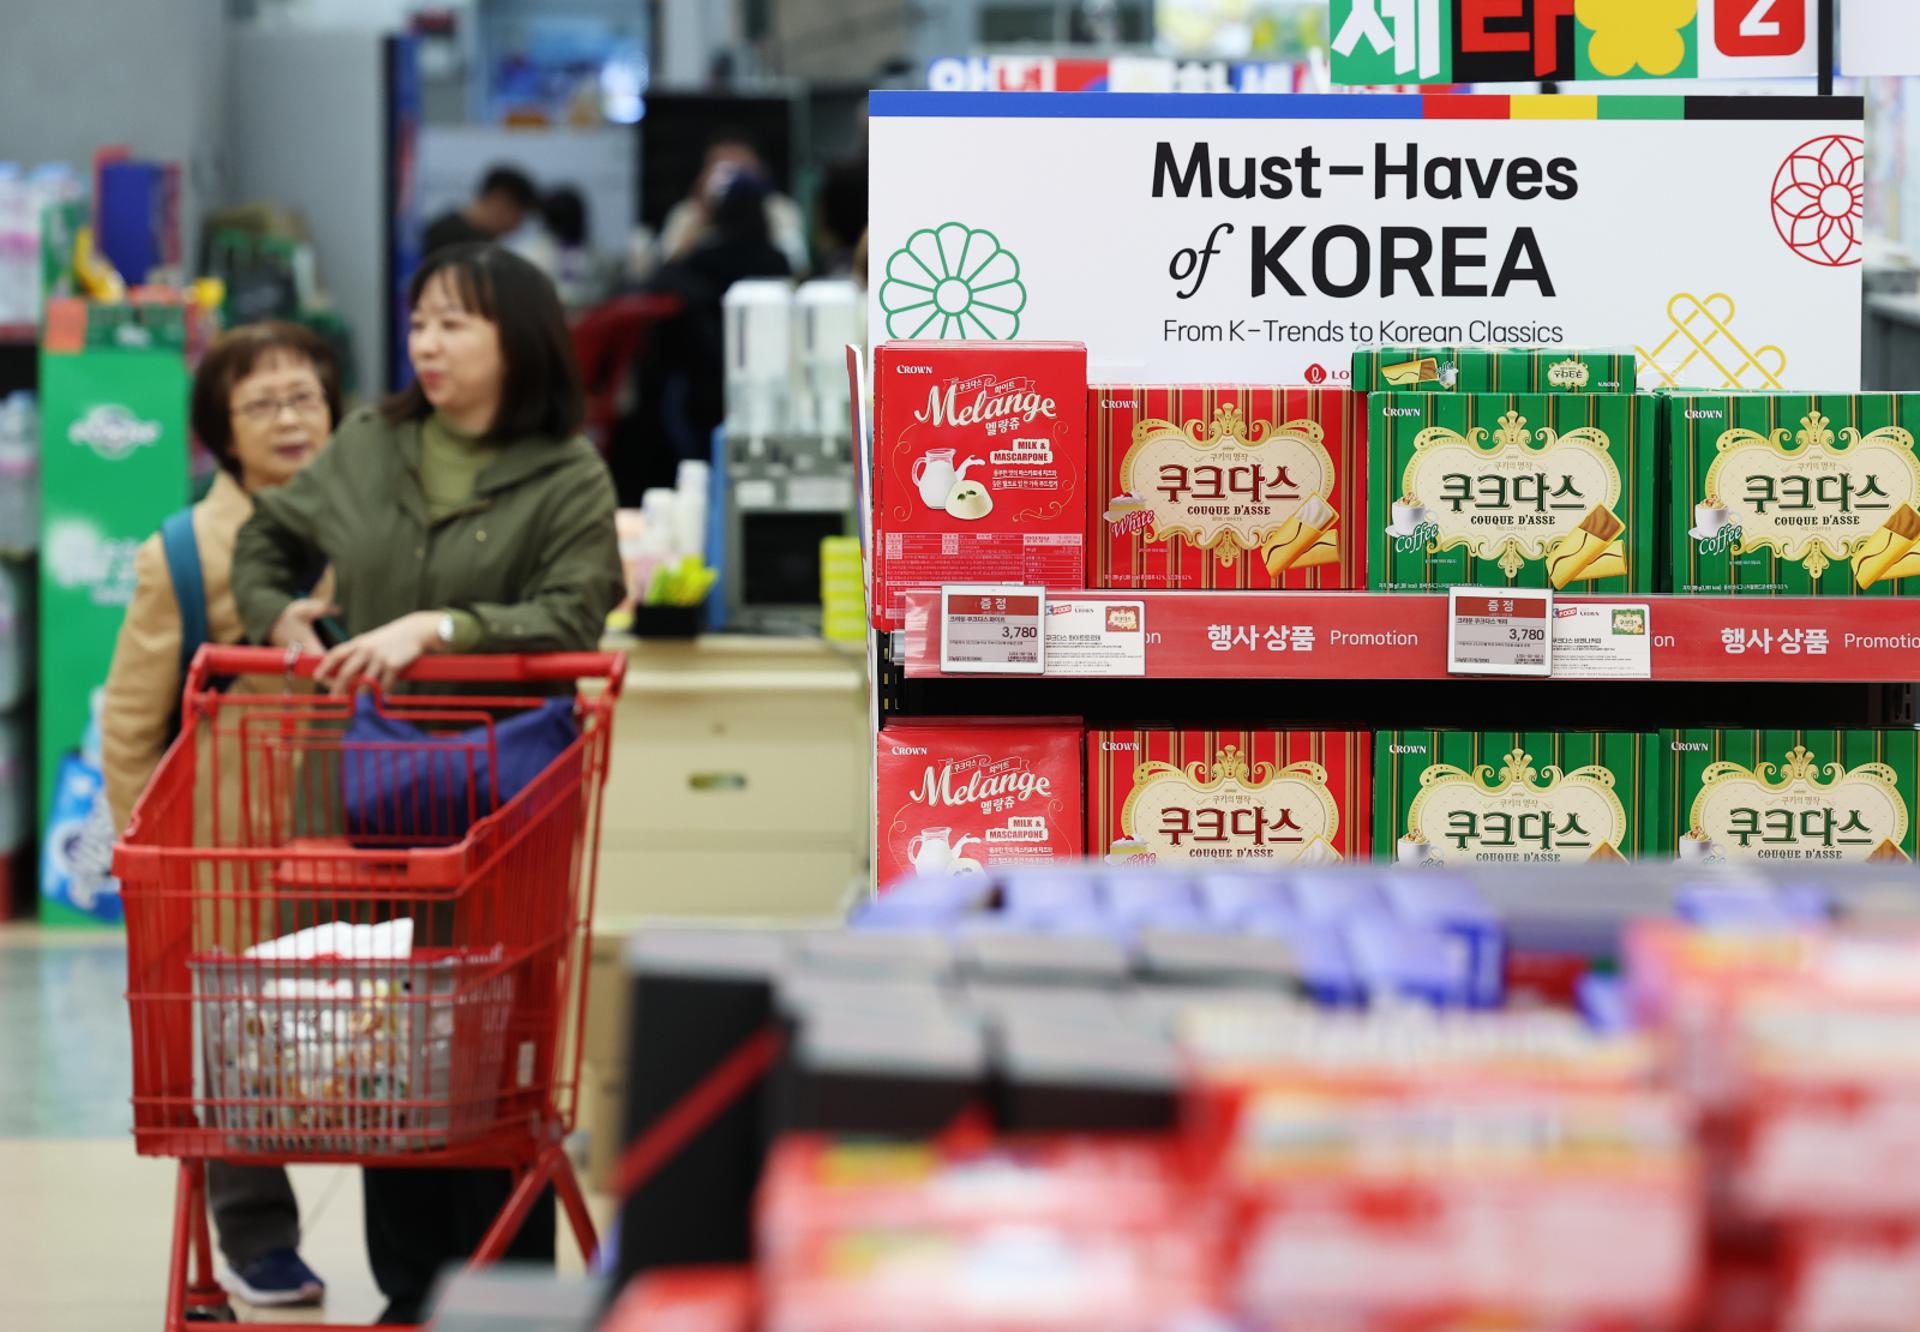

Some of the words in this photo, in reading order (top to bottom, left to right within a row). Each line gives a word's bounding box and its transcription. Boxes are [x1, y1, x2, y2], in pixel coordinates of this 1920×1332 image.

[1152, 142, 1578, 200] Must-Haves
[1170, 223, 1234, 299] of
[1252, 225, 1556, 298] KOREA
[1165, 319, 1226, 342] From
[1230, 319, 1344, 343] K-Trends
[1350, 322, 1373, 343] to
[1380, 320, 1463, 343] Korean
[1469, 319, 1564, 343] Classics
[896, 364, 933, 375] CROWN
[1332, 369, 1351, 380] LO
[914, 385, 1057, 427] Melange
[1101, 399, 1138, 409] CROWN
[1383, 407, 1421, 418] CROWN
[1684, 409, 1722, 419] CROWN
[985, 417, 1020, 437] 멜랑쥬
[1018, 441, 1037, 450] MILK
[994, 453, 1048, 462] MASCARPONE
[1157, 463, 1300, 503] 쿠크다스
[1440, 472, 1586, 512] 쿠크다스
[1743, 472, 1890, 512] 쿠크다스
[1187, 505, 1230, 516] COUQUE
[1233, 504, 1270, 516] D'ASSE
[1110, 509, 1155, 539] White
[1471, 515, 1514, 525] COUQUE
[1518, 514, 1555, 525] D'ASSE
[1774, 516, 1818, 526] COUQUE
[1822, 515, 1860, 525] D'ASSE
[1395, 521, 1439, 554] Coffee
[1699, 523, 1743, 555] Coffee
[1002, 626, 1038, 640] 3,780
[1330, 630, 1418, 646] Promotion
[1509, 628, 1545, 641] 3,780
[892, 745, 927, 756] CROWN
[1102, 742, 1139, 751] CROWN
[1389, 744, 1427, 754] CROWN
[1671, 741, 1709, 751] CROWN
[909, 765, 1052, 807] Melange
[1013, 819, 1033, 827] MILK
[1158, 806, 1303, 846] 쿠크다스
[1727, 806, 1873, 847] 쿠크다스
[989, 830, 1043, 839] MASCARPONE
[1445, 810, 1591, 850] 쿠크다스
[1189, 848, 1233, 858] COUQUE
[1237, 847, 1274, 858] D'ASSE
[1476, 852, 1520, 862] COUQUE
[1524, 851, 1561, 862] D'ASSE
[1758, 850, 1801, 859] COUQUE
[1805, 849, 1843, 859] D'ASSE
